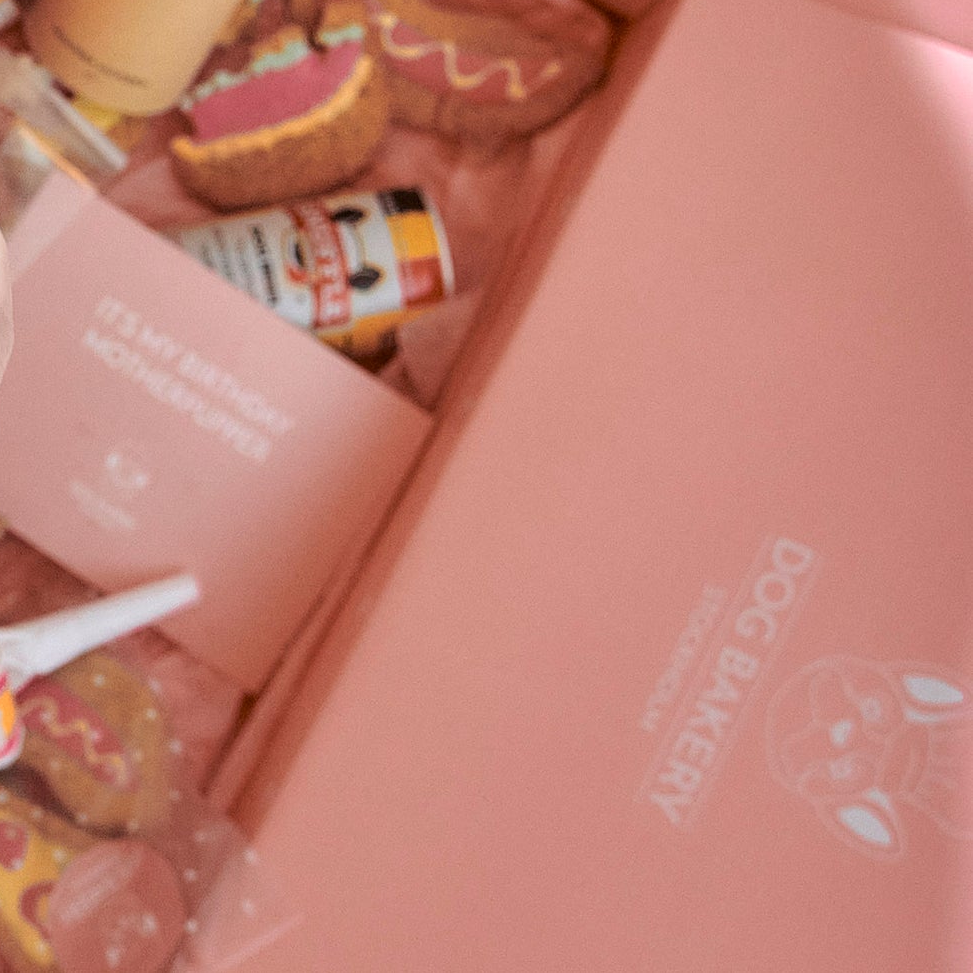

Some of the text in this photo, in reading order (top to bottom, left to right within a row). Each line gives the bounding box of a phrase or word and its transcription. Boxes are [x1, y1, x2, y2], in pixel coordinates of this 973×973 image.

[137, 326, 179, 364] MY
[647, 536, 814, 825] DOG BAKERY
